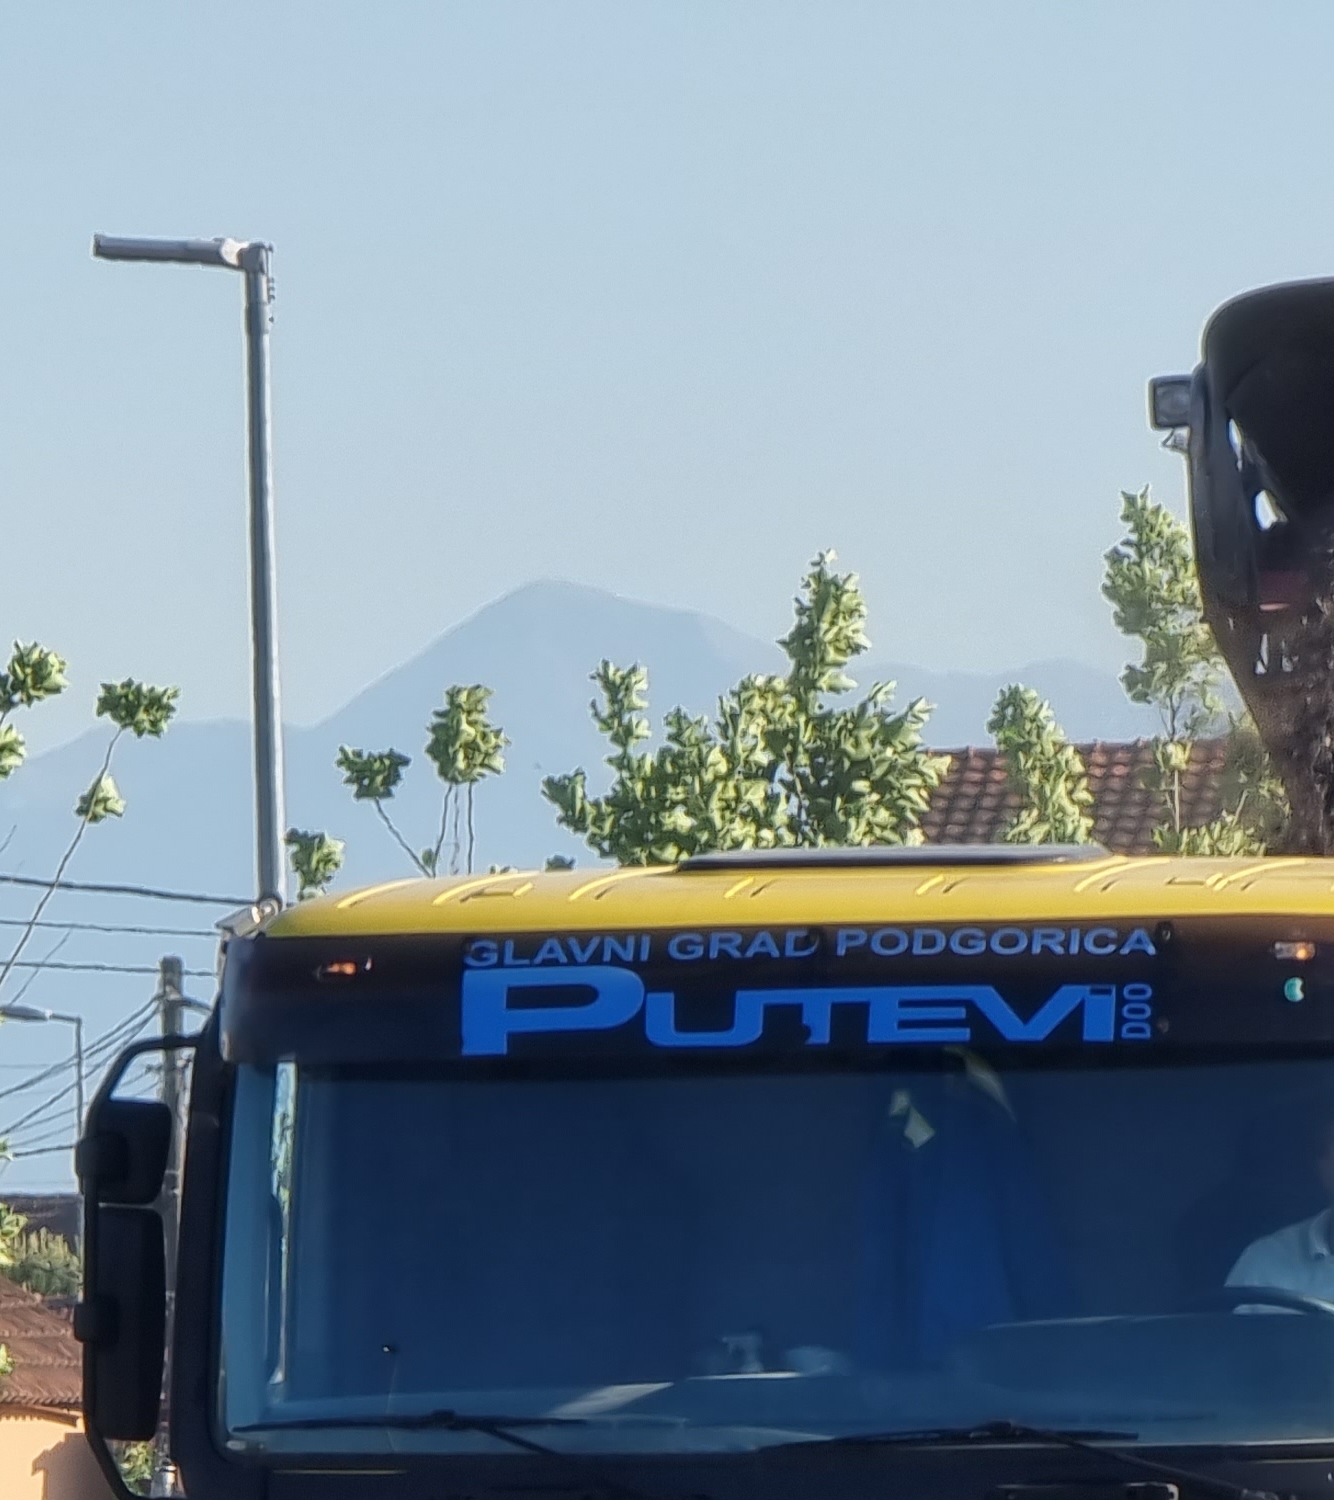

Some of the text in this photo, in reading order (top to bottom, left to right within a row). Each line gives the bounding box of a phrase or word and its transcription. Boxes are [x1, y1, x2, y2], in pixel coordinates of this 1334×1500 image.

[464, 927, 1157, 967] GLAVNI GRAD PODGORICA
[461, 965, 1116, 1056] PUTEVI
[1120, 983, 1153, 1040] DOO
